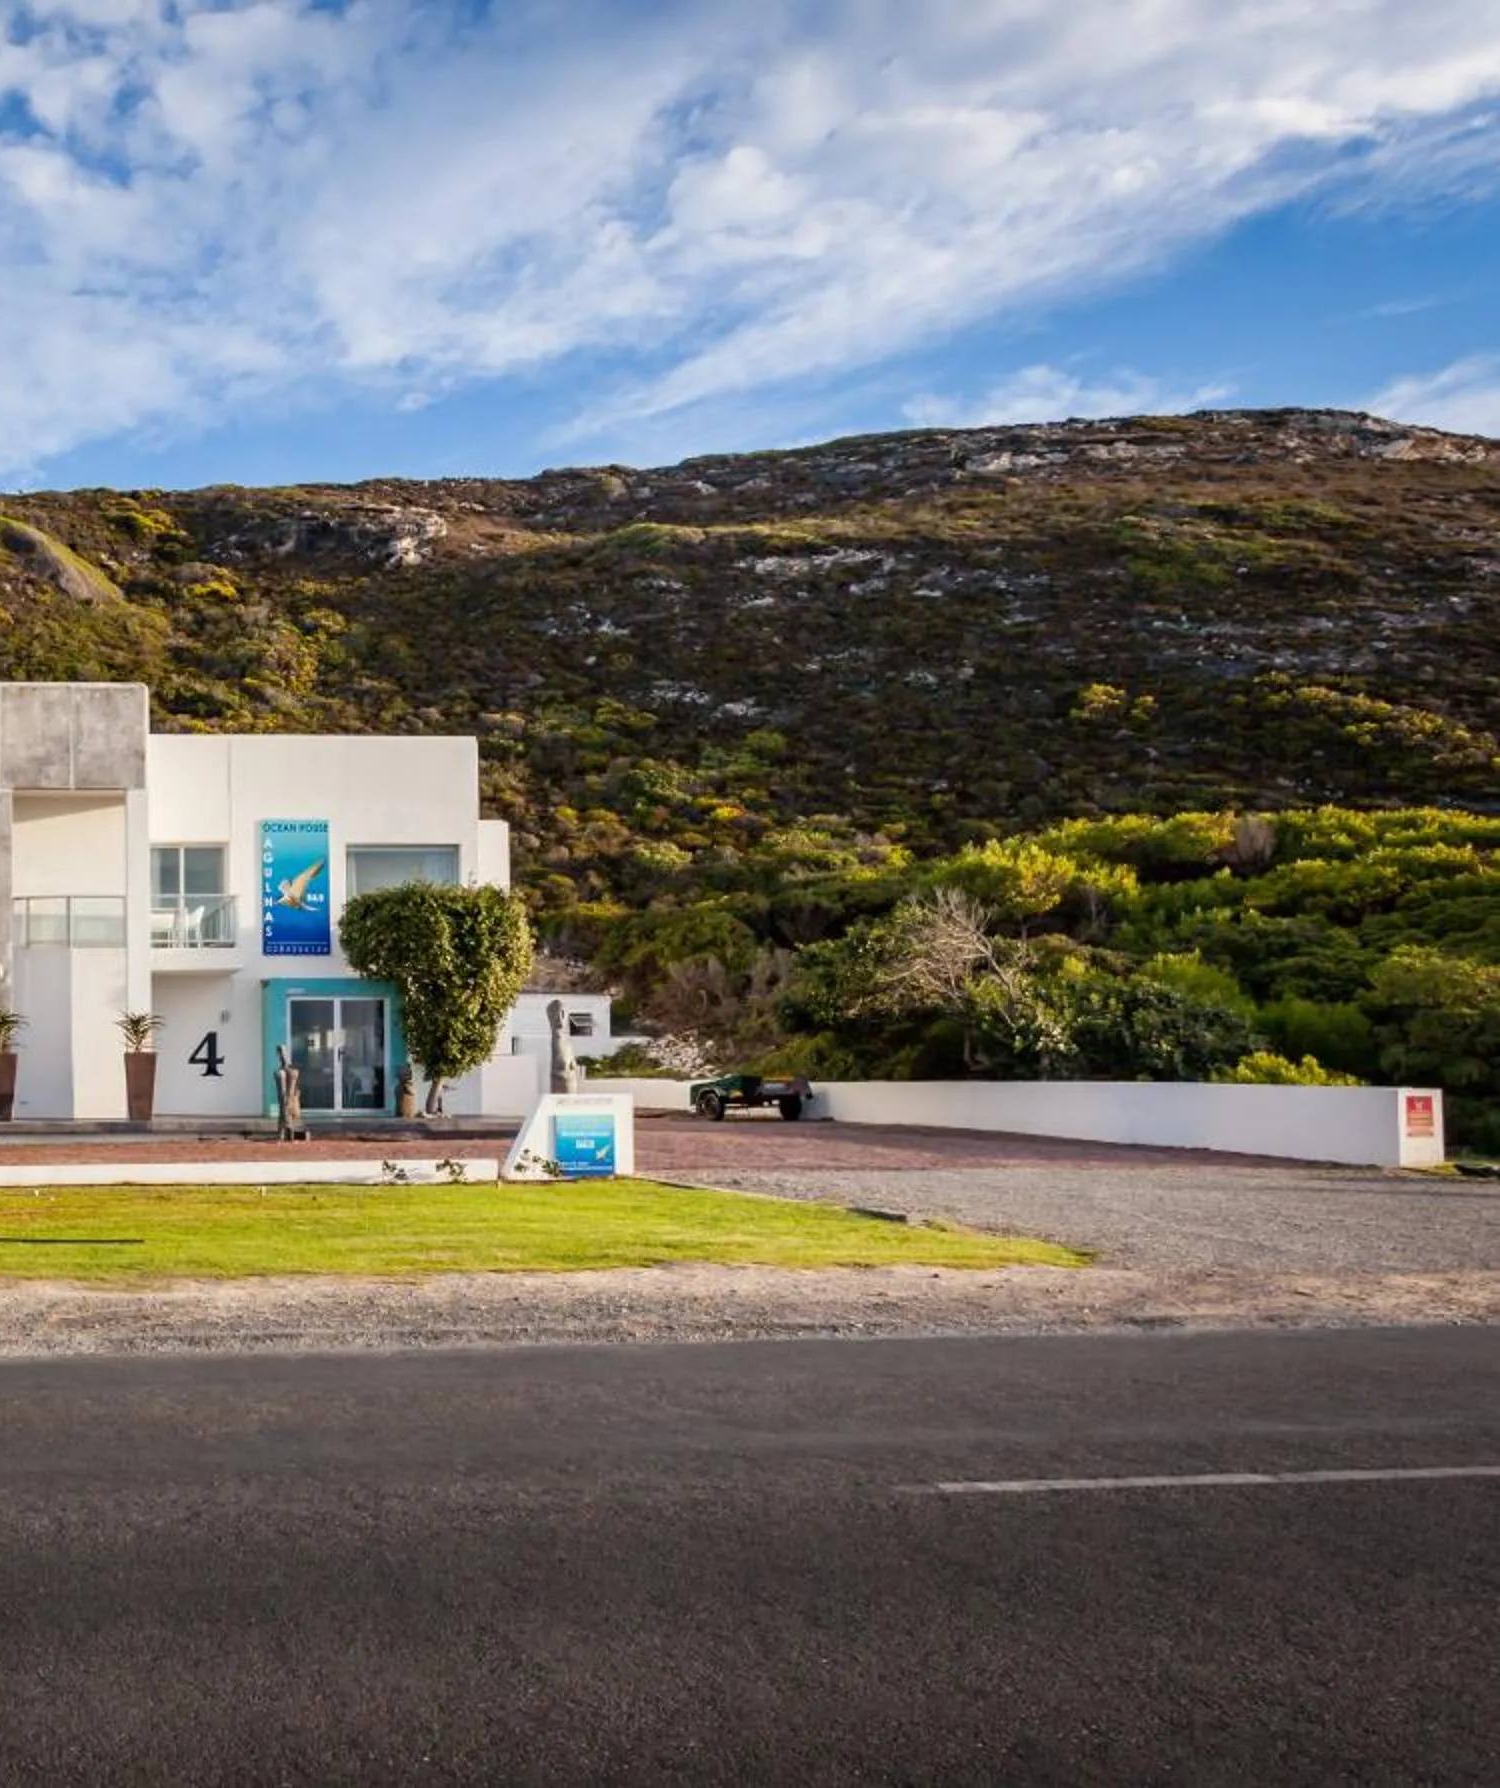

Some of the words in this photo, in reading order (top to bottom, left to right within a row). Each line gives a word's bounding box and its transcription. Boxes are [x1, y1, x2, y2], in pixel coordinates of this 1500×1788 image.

[263, 823, 296, 833] OCEAN
[263, 837, 274, 938] AGULHAS
[188, 1031, 225, 1077] 4
